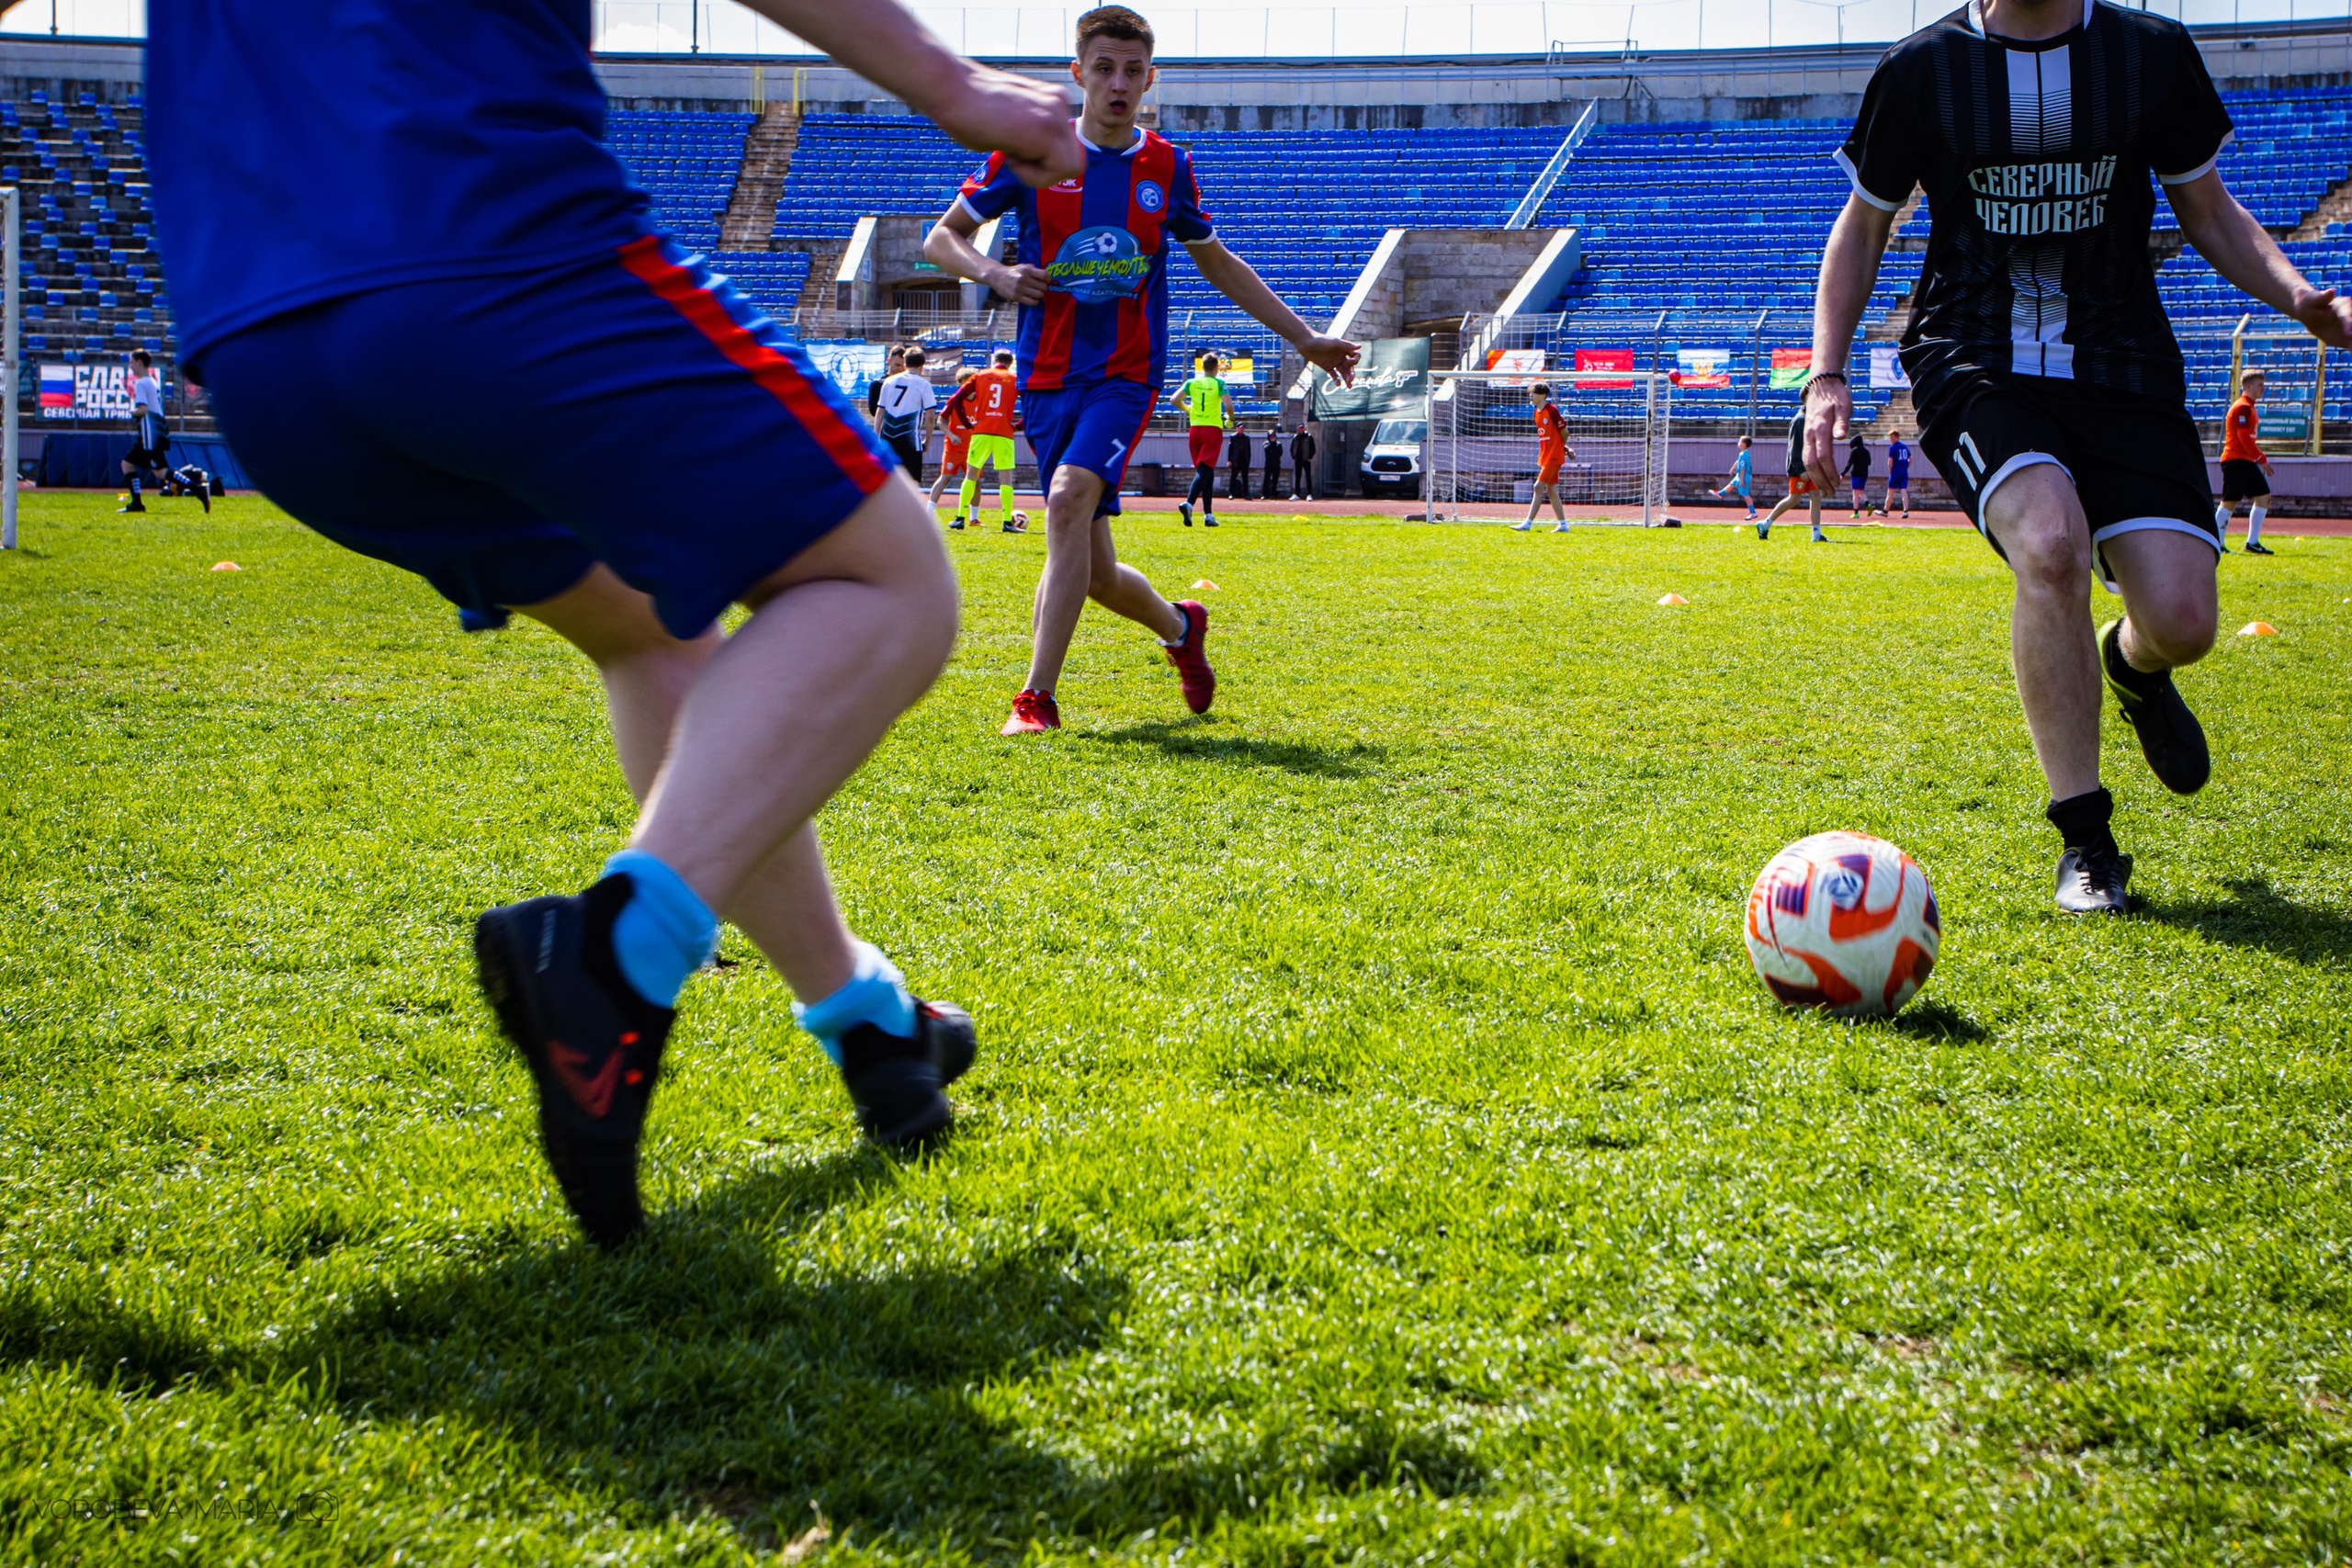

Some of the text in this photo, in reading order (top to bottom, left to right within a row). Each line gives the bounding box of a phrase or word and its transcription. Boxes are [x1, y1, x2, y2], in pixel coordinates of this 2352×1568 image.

[1968, 155, 2117, 197] СЕВЕРНЫЙ
[1975, 194, 2109, 235] ЧЕЛОВЕК
[75, 389, 135, 410] РОСС
[893, 384, 908, 407] 7
[989, 383, 1002, 409] 3
[1201, 392, 1205, 412] 1
[1104, 438, 1126, 468] 7
[1898, 448, 1908, 460] 10
[1953, 432, 1986, 491] 11
